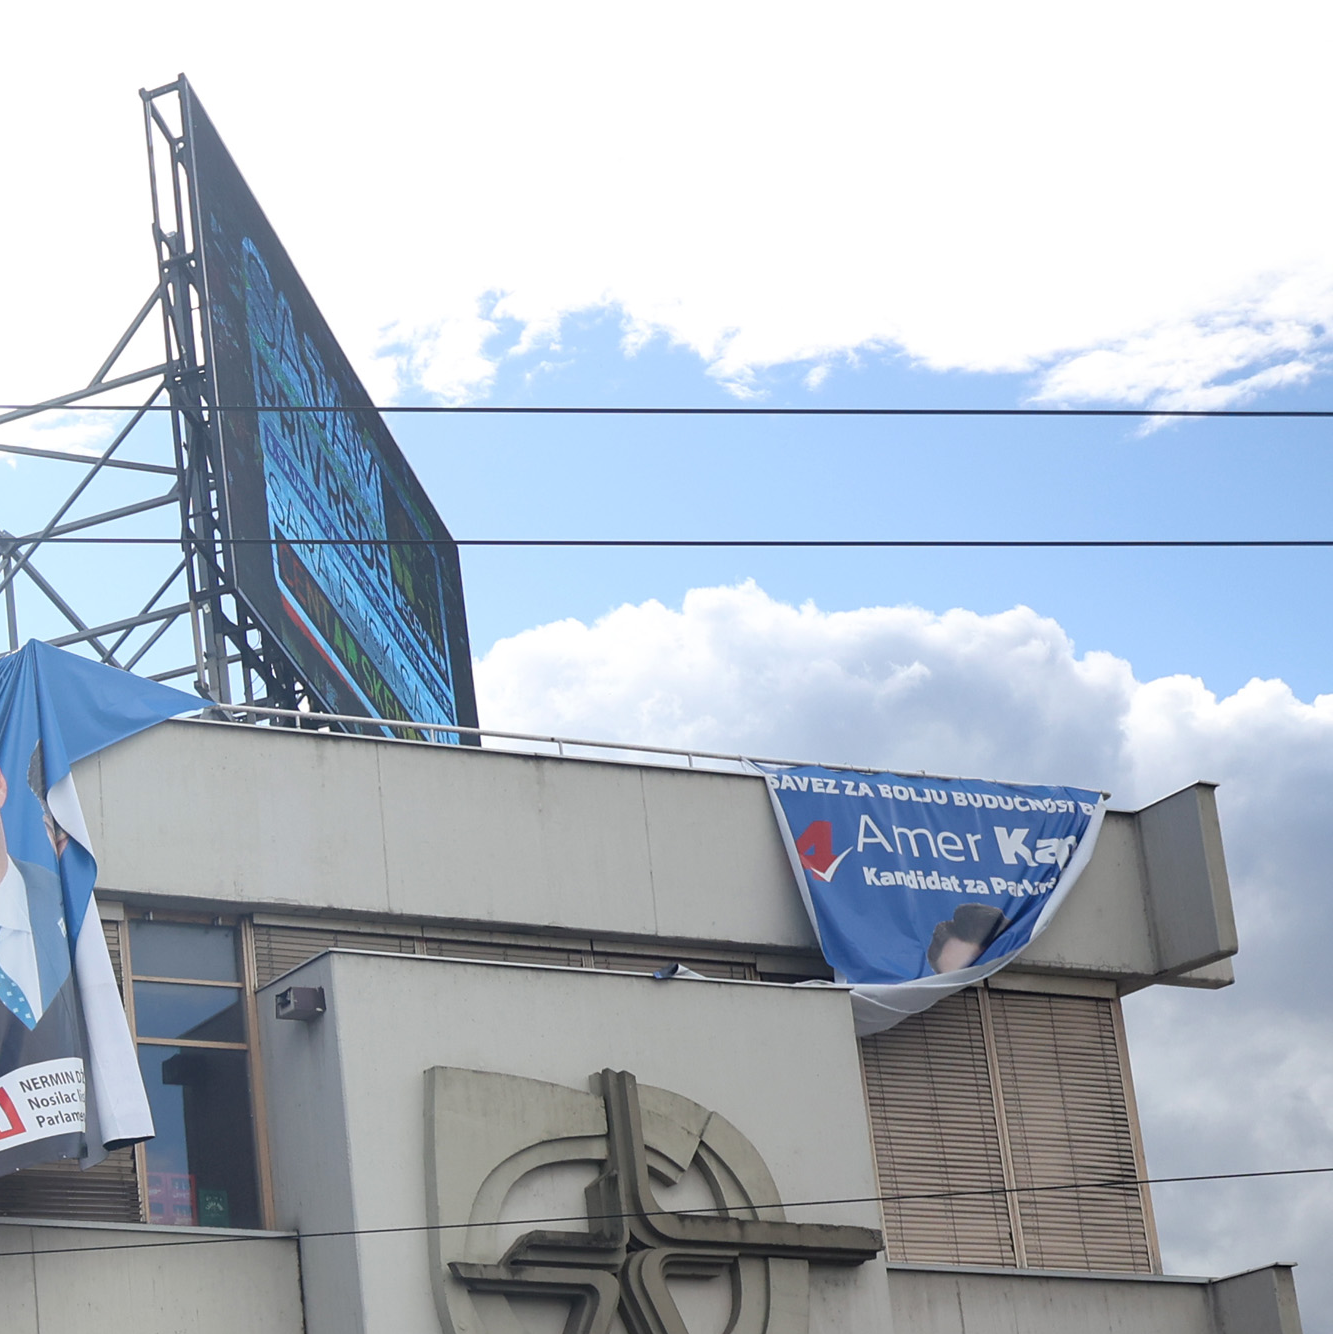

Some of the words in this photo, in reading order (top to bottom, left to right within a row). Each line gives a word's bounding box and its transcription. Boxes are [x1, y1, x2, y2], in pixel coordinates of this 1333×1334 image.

[769, 774, 840, 795] SAVEZ
[844, 780, 875, 798] ZA
[878, 783, 948, 805] BOLJU
[856, 814, 982, 863] Amer
[863, 866, 960, 893] Kandidat
[964, 879, 990, 895] za
[19, 1071, 75, 1093] NERMIN
[27, 1091, 77, 1111] Nosilac
